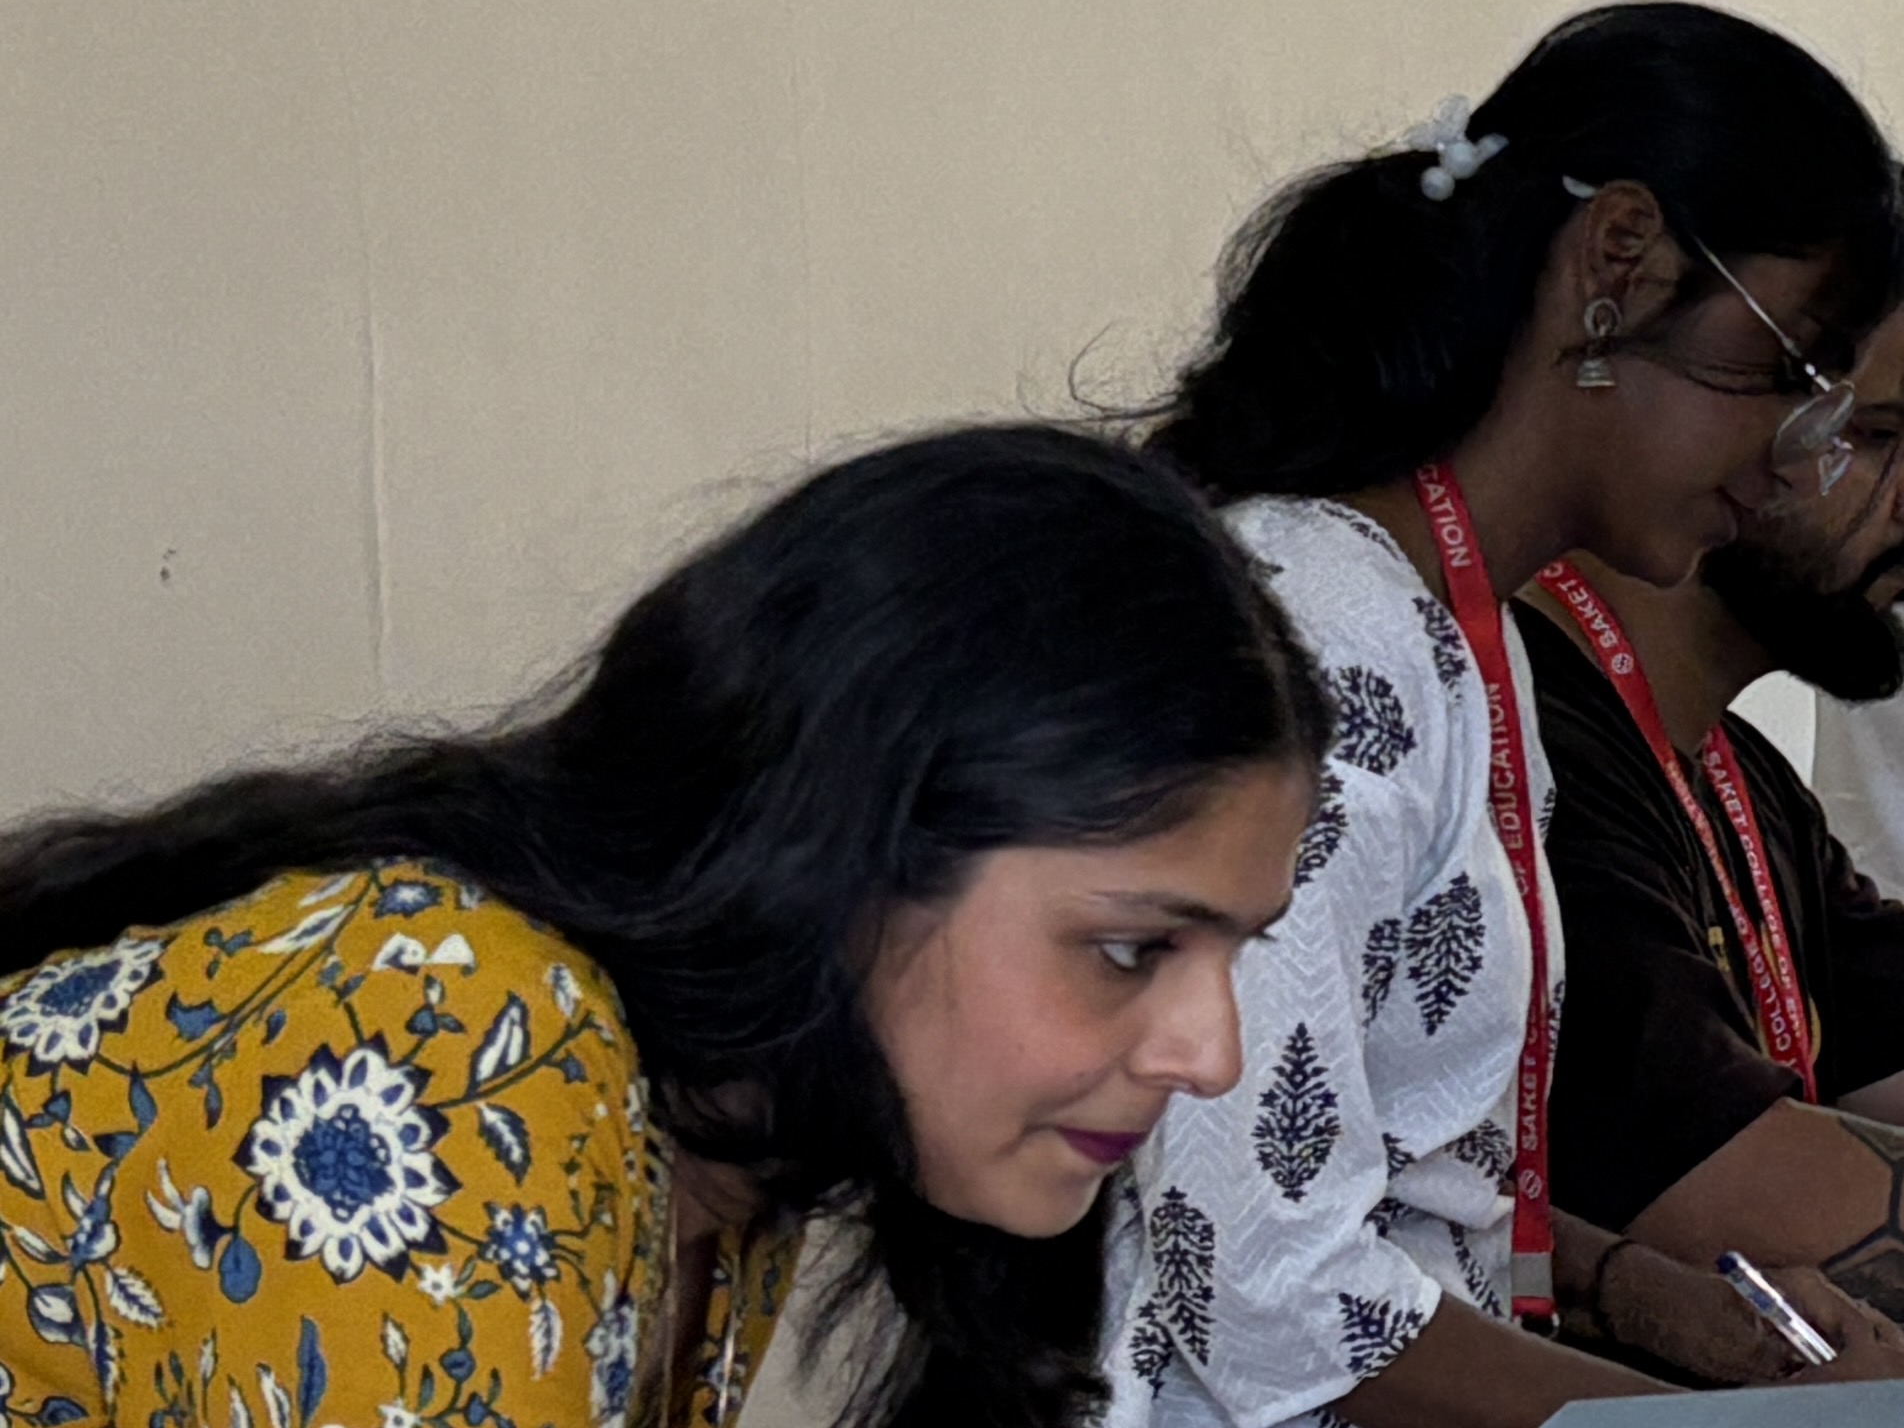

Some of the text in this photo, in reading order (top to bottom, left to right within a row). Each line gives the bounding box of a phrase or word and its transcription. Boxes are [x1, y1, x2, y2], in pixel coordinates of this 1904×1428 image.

[1417, 464, 1471, 567] CATION
[1557, 579, 1618, 649] SAKET
[1704, 750, 1748, 827] SAKET
